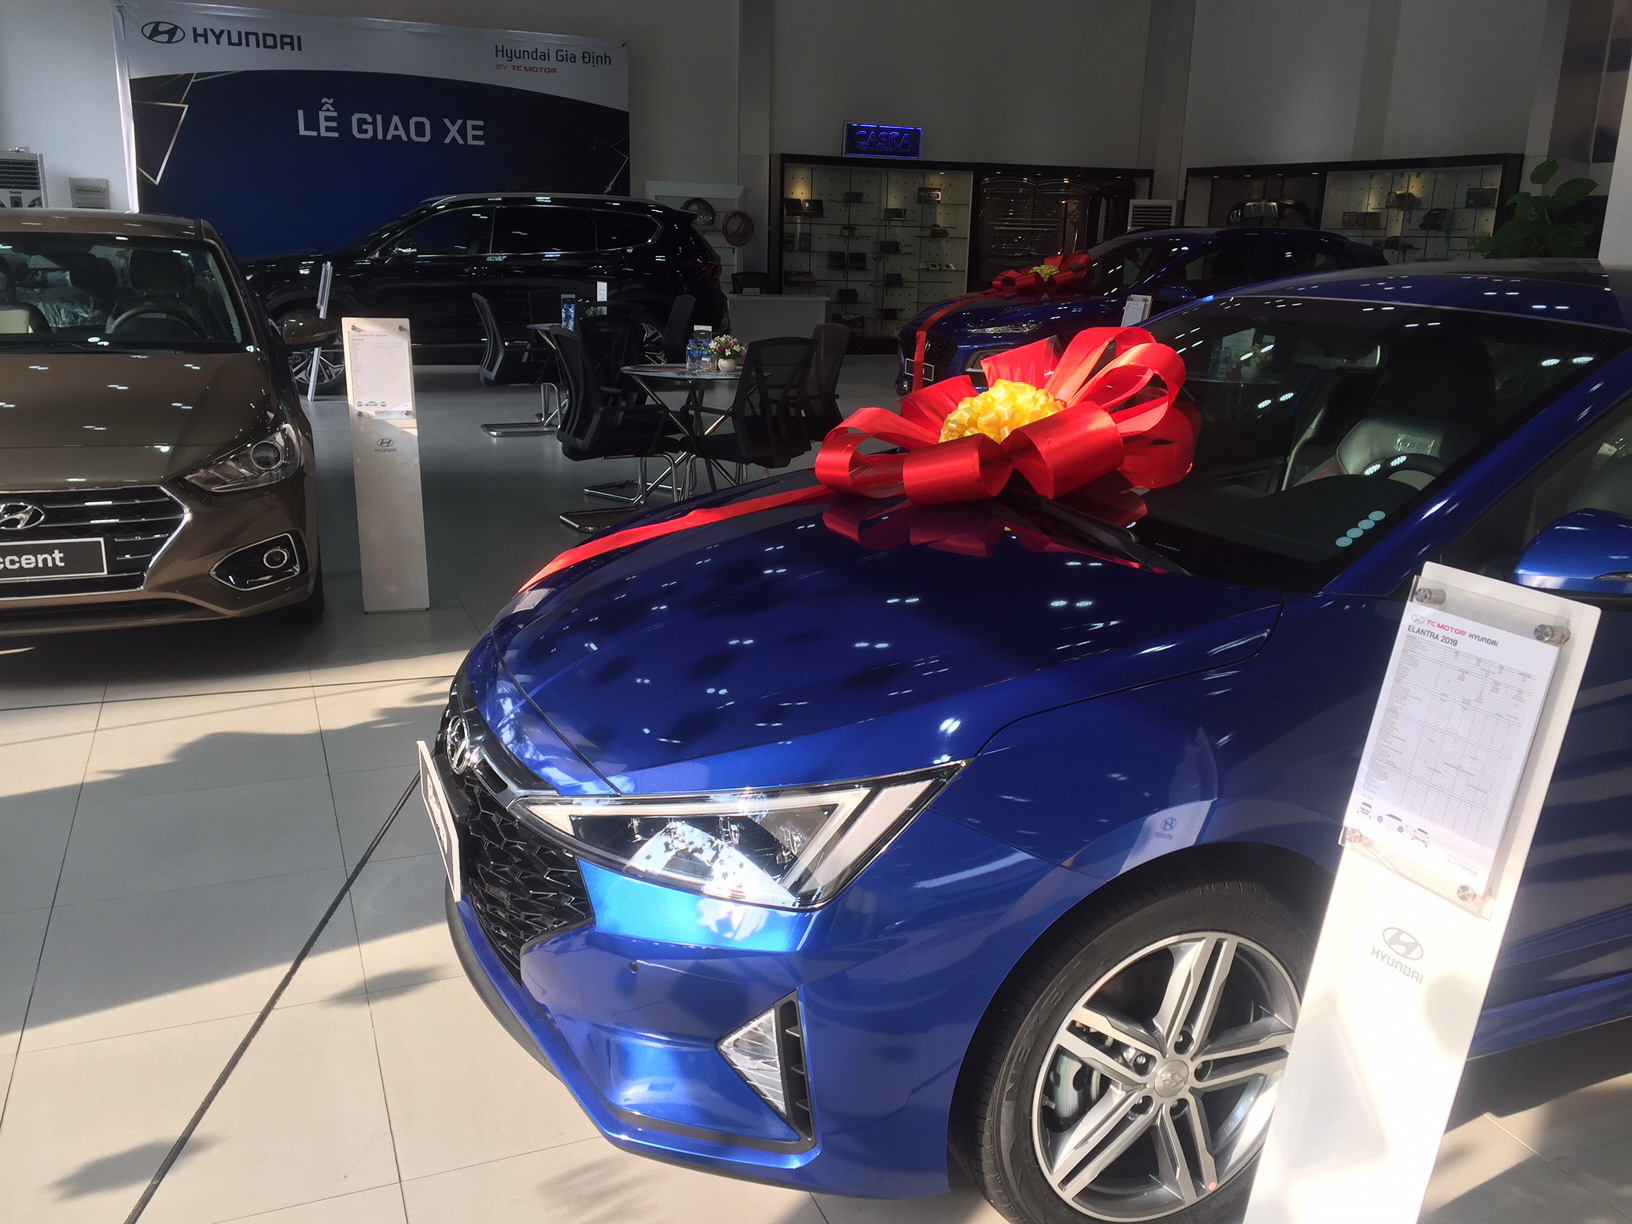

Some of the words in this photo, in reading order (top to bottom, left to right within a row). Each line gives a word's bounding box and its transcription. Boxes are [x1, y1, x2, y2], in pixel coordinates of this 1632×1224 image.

[192, 26, 303, 52] HYUNDAI
[495, 45, 550, 62] Hyundai
[555, 49, 577, 63] Gia
[581, 51, 612, 67] Định
[524, 66, 557, 74] MOTOR
[297, 97, 339, 138] LỄ
[351, 112, 431, 143] GIAO
[443, 118, 486, 146] XE
[855, 130, 912, 148] CASKA
[1407, 624, 1440, 641] ELANTRA
[1440, 635, 1459, 647] 2019
[1426, 619, 1437, 627] TC
[1436, 623, 1467, 636] MOTOR
[1468, 632, 1499, 647] HYUNDAI
[1371, 946, 1424, 986] HYUNDAI
